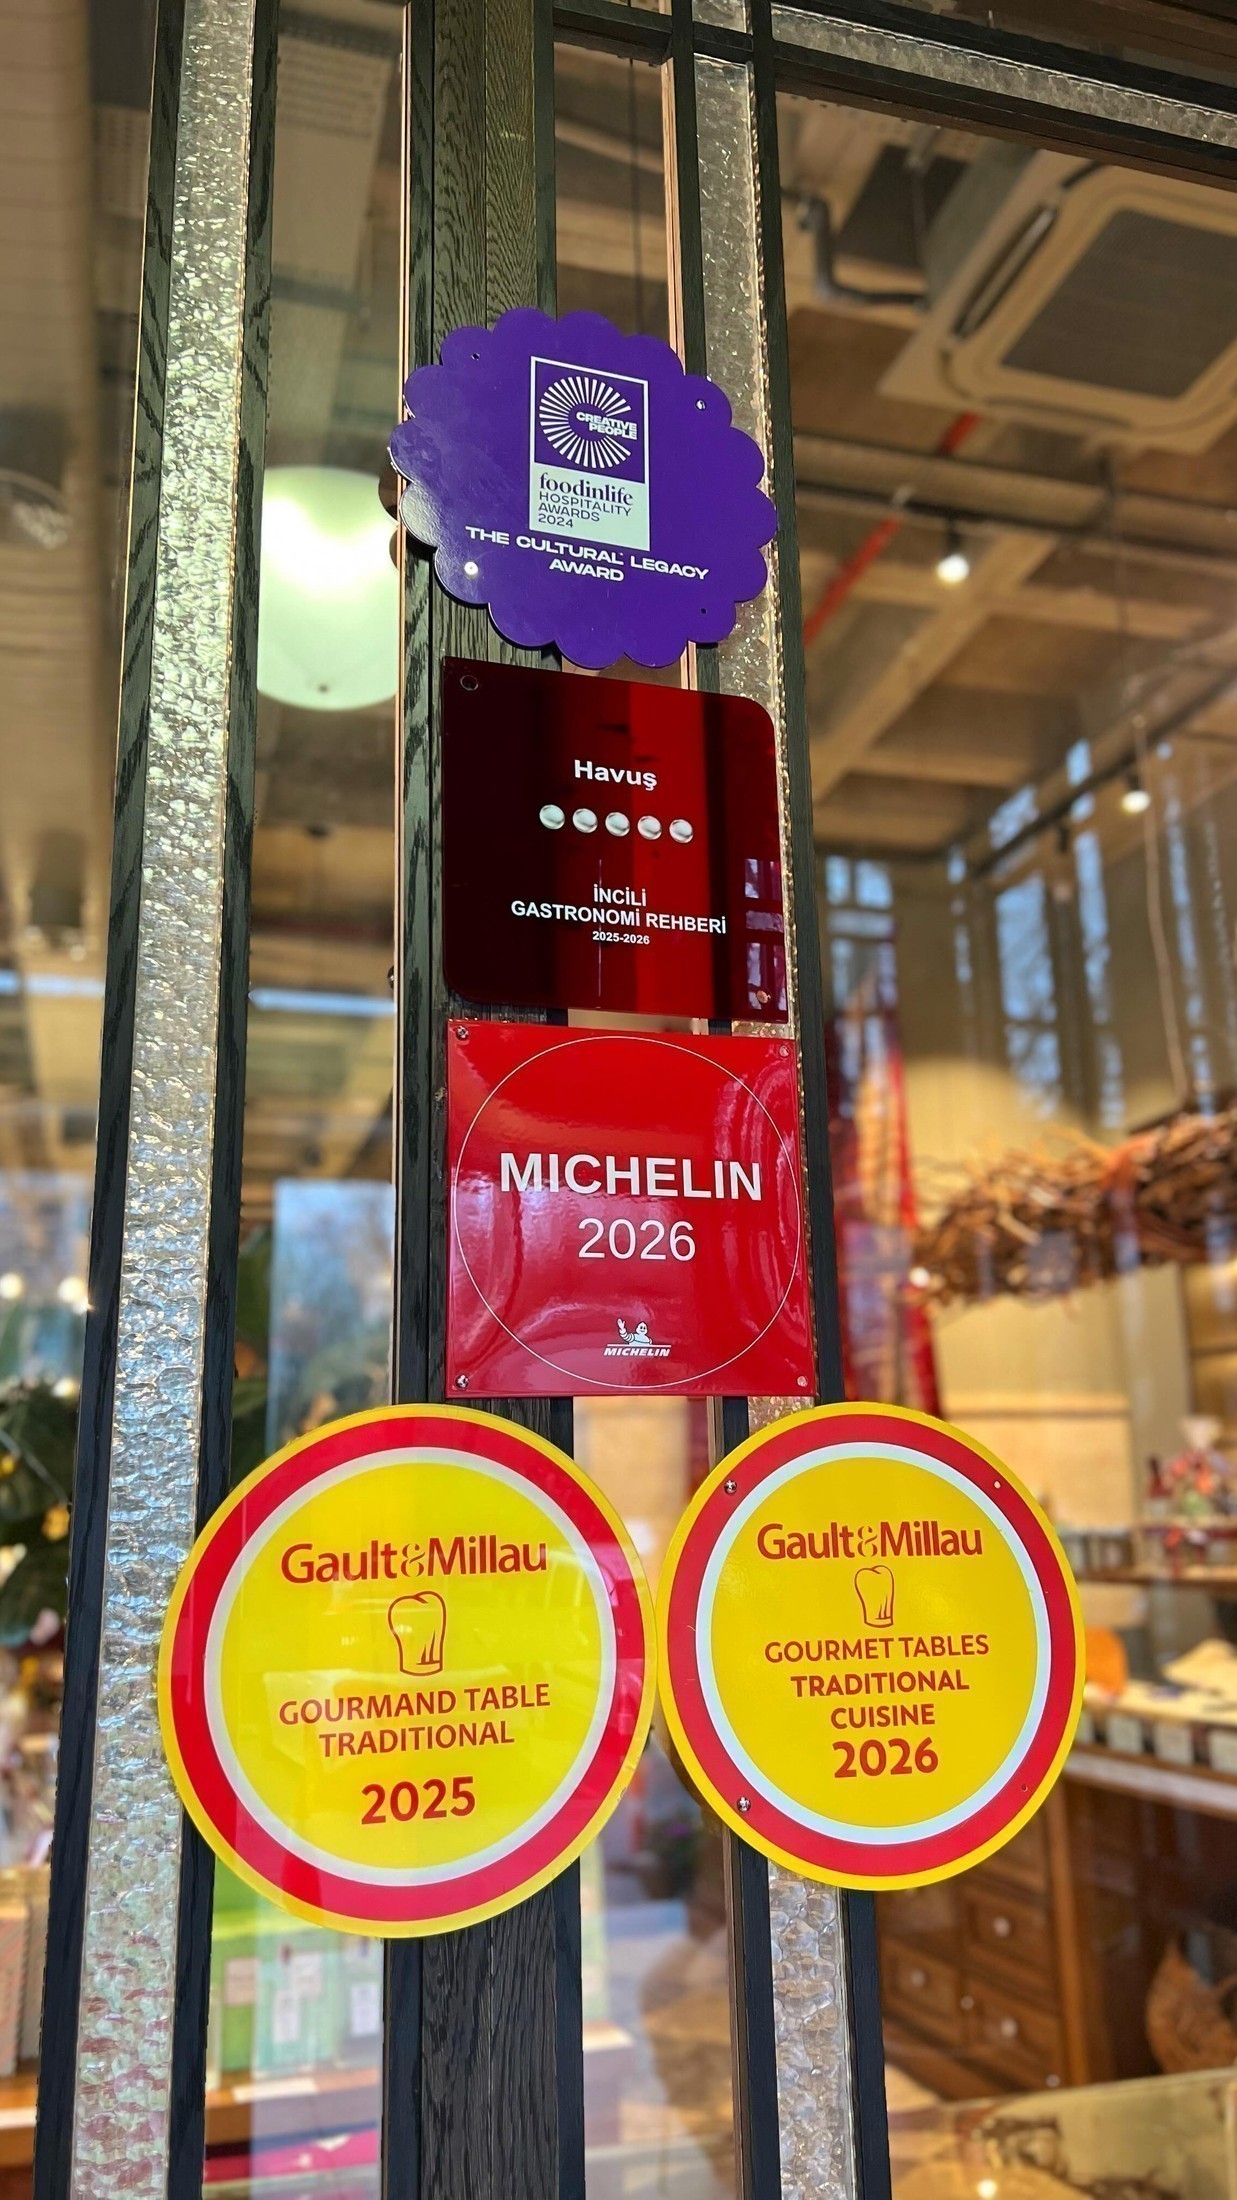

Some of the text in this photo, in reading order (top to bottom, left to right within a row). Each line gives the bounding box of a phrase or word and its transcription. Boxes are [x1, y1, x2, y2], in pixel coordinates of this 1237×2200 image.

[576, 411, 637, 432] CREATIVE
[589, 422, 637, 440] PEOPLE
[539, 473, 634, 506] foodinlife
[539, 492, 632, 517] HOSPITALITY
[538, 502, 600, 522] AWARDS
[538, 513, 574, 528] 2024
[465, 525, 709, 580] THE CULTURAL LEGACY
[549, 558, 624, 582] AWARD
[574, 759, 658, 791] Havuş
[593, 883, 647, 907] İNCİLİ
[511, 900, 727, 934] GASTRONOMİ REHBERİ
[592, 930, 650, 945] 2025-2026
[500, 1152, 762, 1201] MICHELIN
[578, 1218, 696, 1261] 2026
[603, 1347, 671, 1357] MICHELIN
[757, 1520, 983, 1560] Gault&Millau
[281, 1534, 548, 1585] Gault&Millau
[764, 1634, 990, 1664] GOURMET TABLES
[790, 1670, 970, 1698] TRADITIONAL
[278, 1682, 551, 1725] GOURMAND TABLE
[830, 1703, 936, 1729] CUISINE
[319, 1720, 515, 1757] TRADITIONAL
[833, 1737, 939, 1778] 2026
[360, 1775, 476, 1825] 2025
